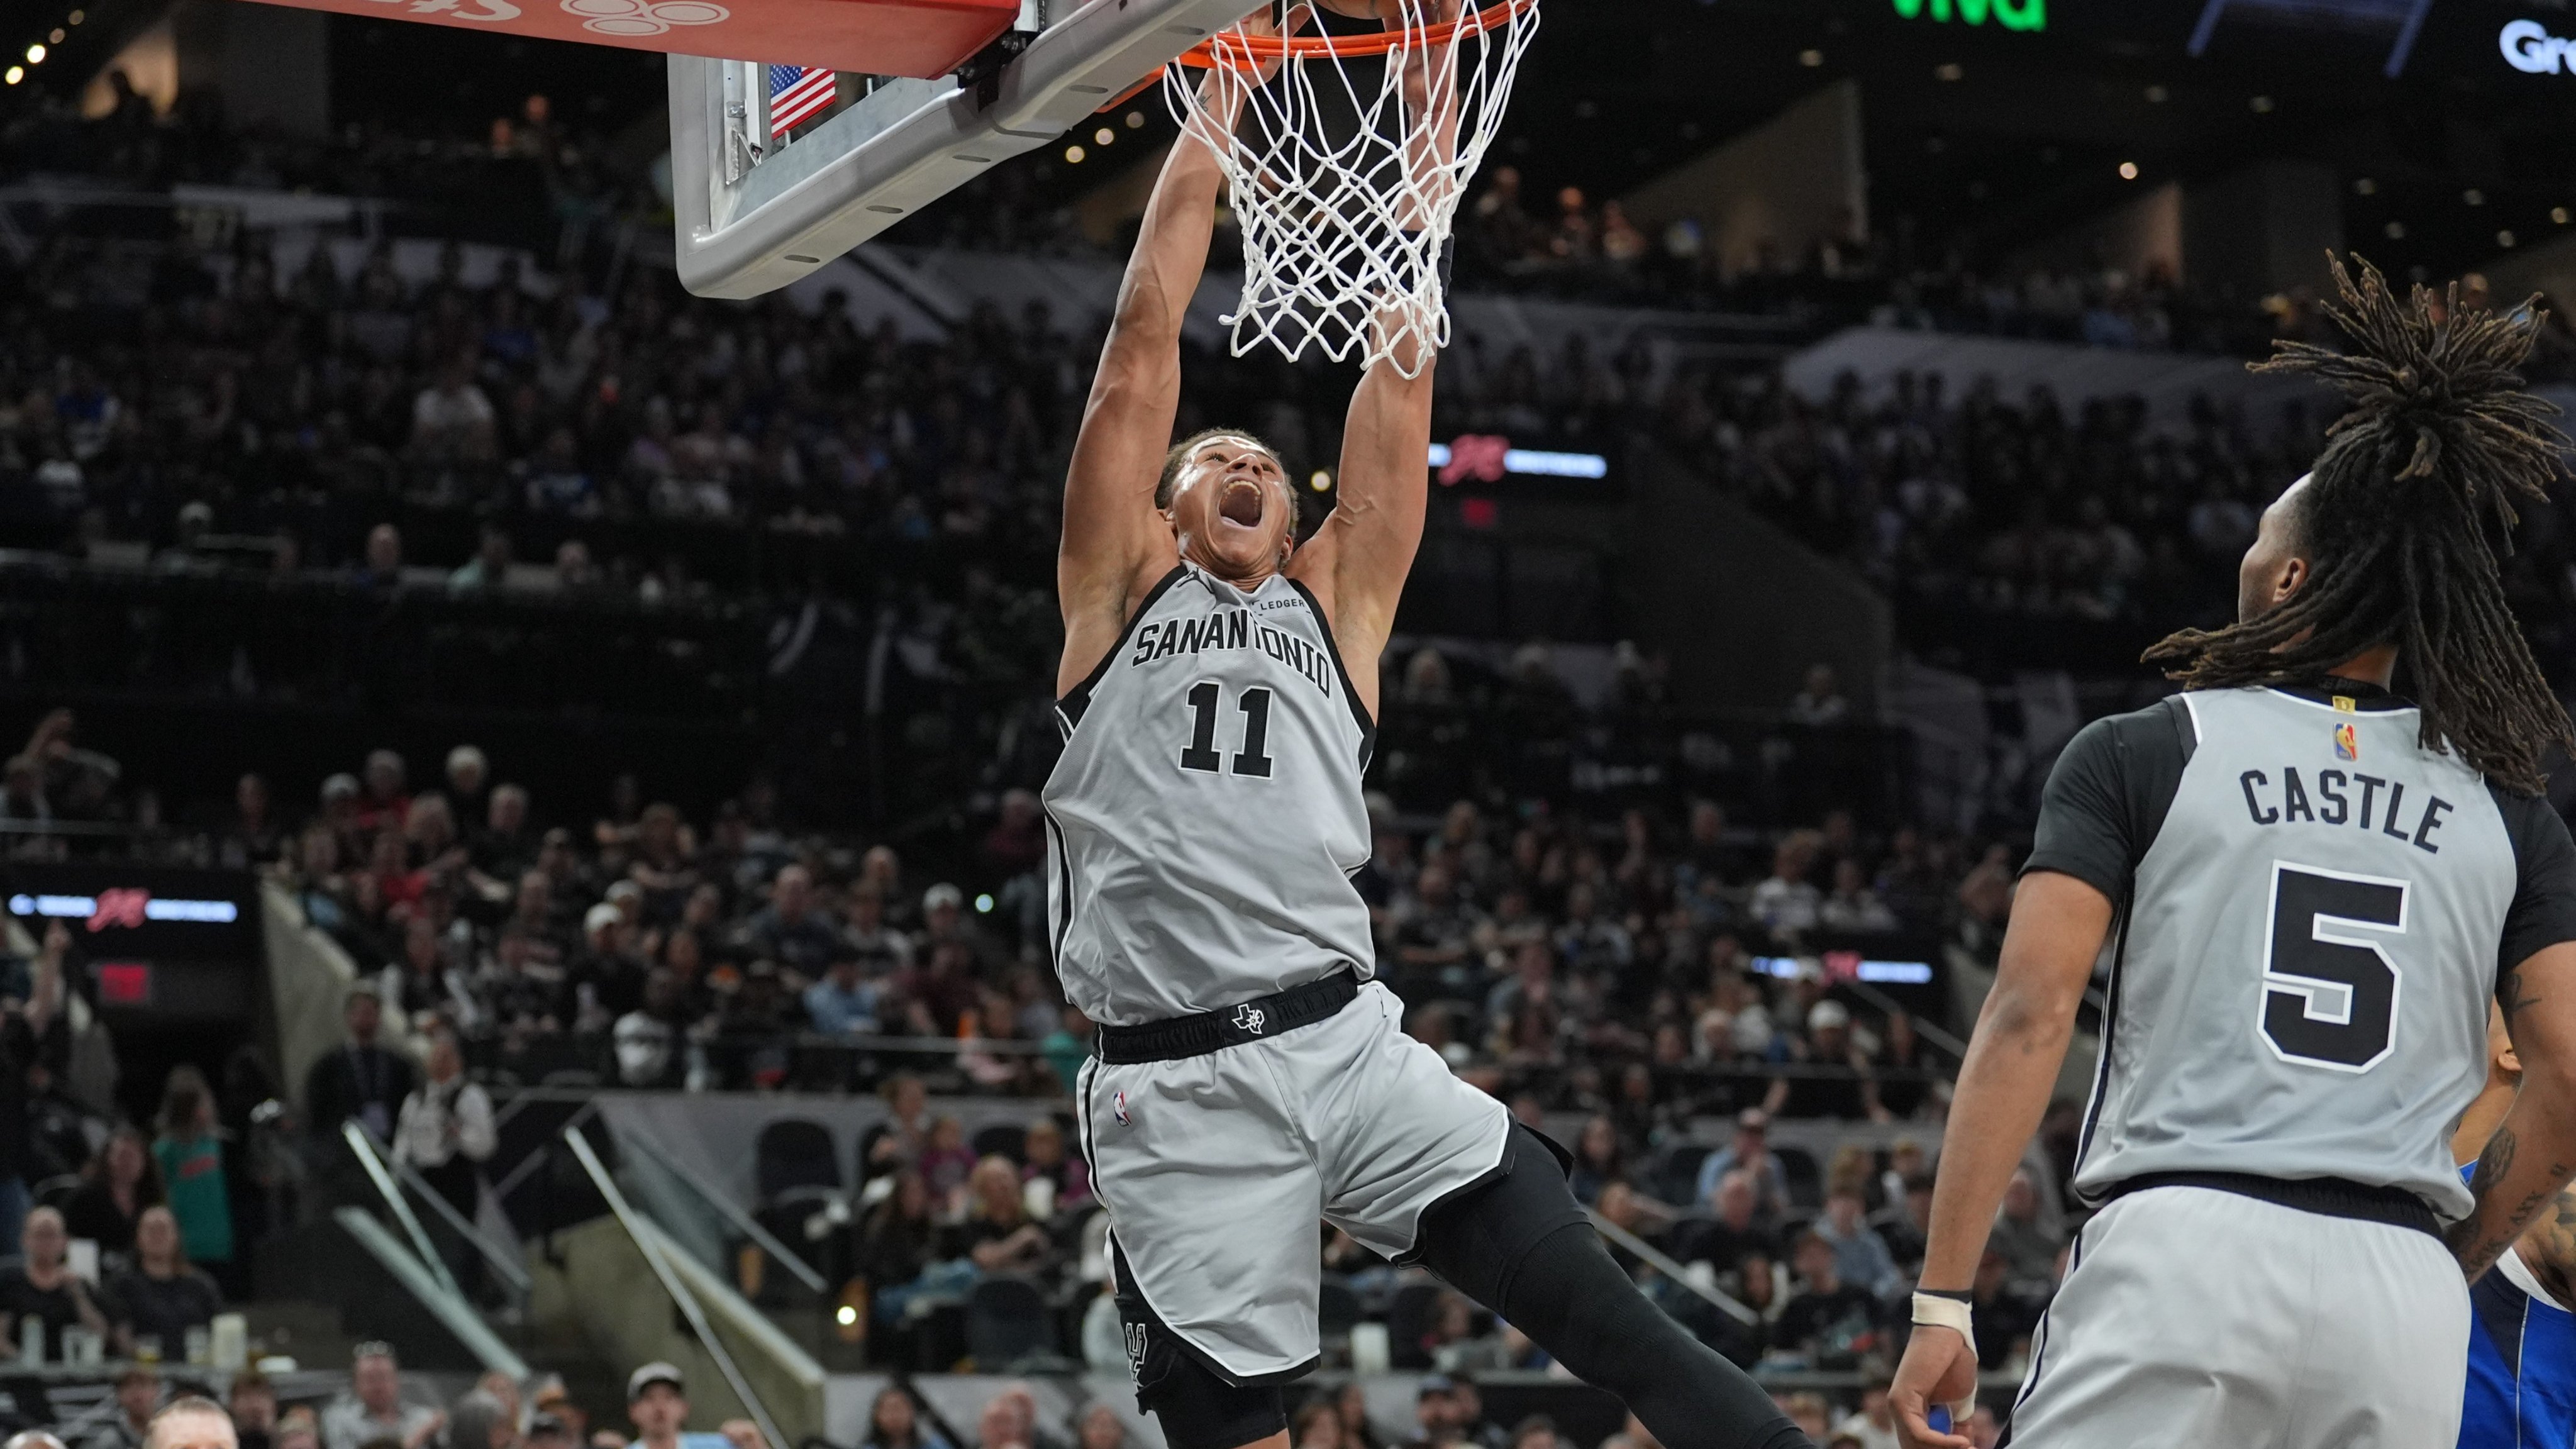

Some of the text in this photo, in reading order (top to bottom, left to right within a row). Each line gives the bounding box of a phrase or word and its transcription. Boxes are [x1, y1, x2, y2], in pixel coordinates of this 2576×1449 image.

[1260, 598, 1305, 610] LEDGER
[1177, 679, 1274, 780] 11
[2240, 766, 2454, 854] CASTLE
[2255, 858, 2411, 1074] 5
